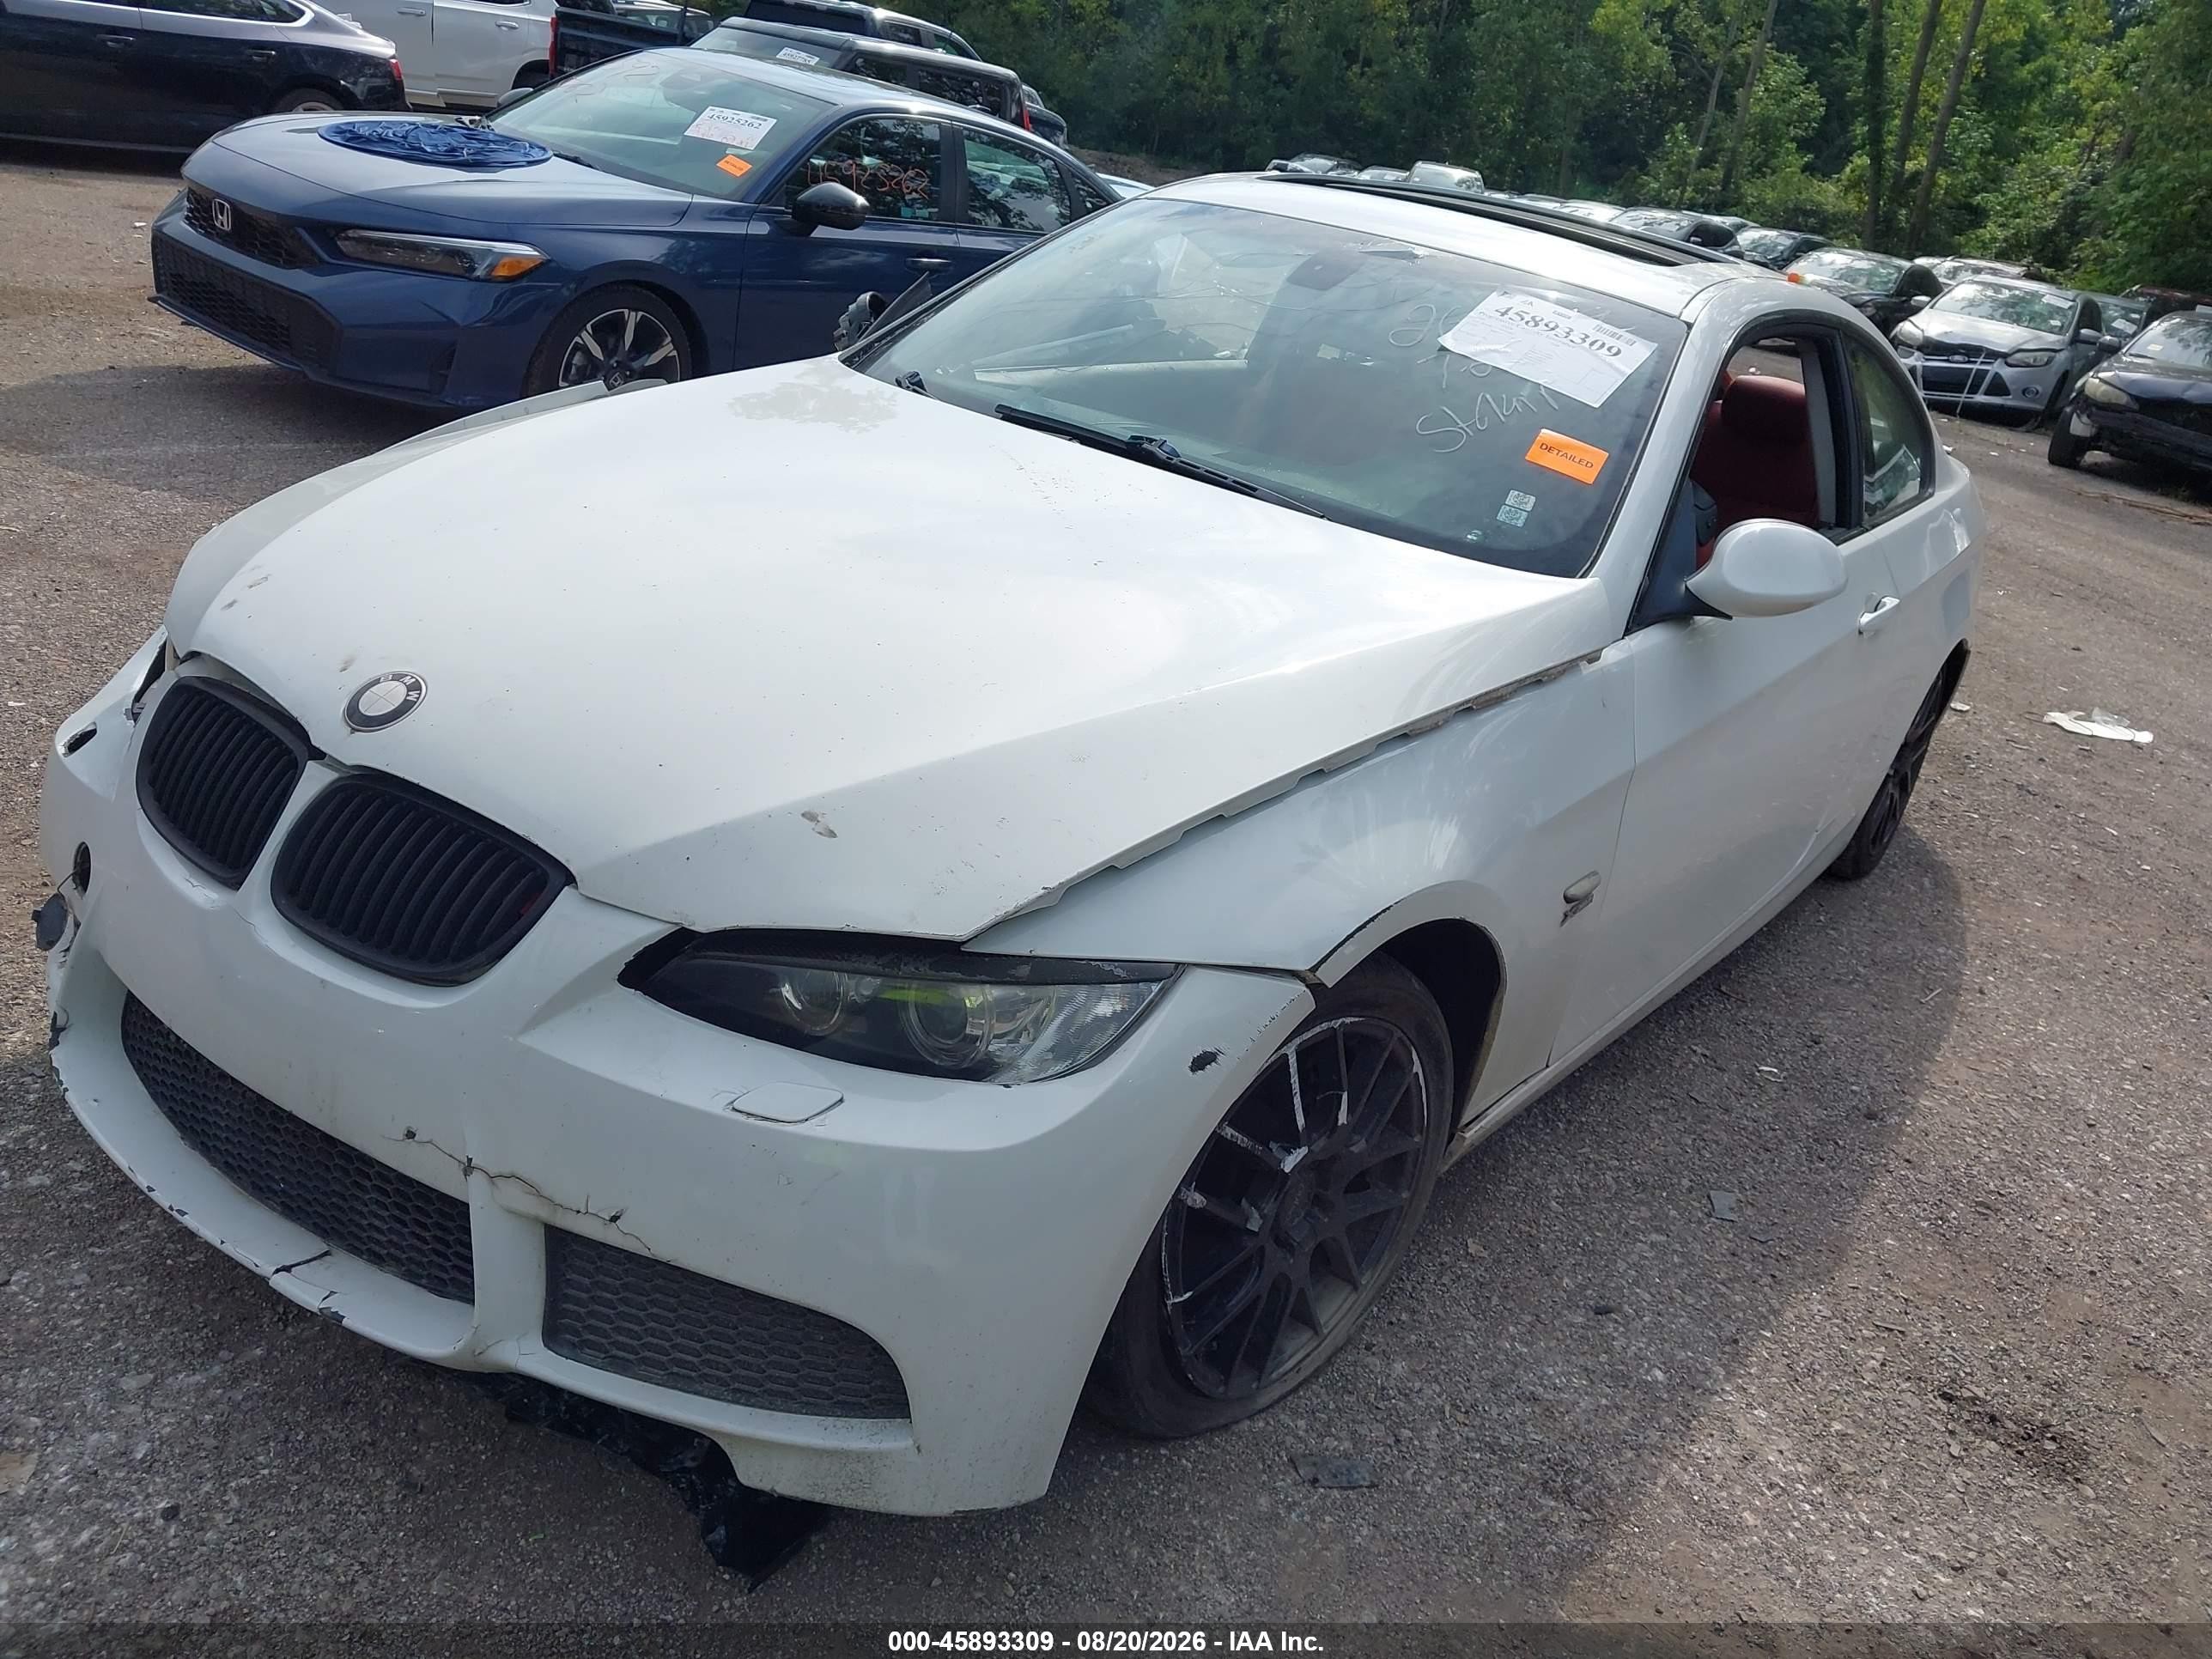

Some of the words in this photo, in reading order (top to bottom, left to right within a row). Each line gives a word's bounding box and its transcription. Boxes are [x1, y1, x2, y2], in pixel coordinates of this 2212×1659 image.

[707, 113, 763, 129] 45925262
[1495, 306, 1622, 357] 45893309
[1540, 442, 1594, 469] DETAILED
[379, 674, 421, 701] BMW
